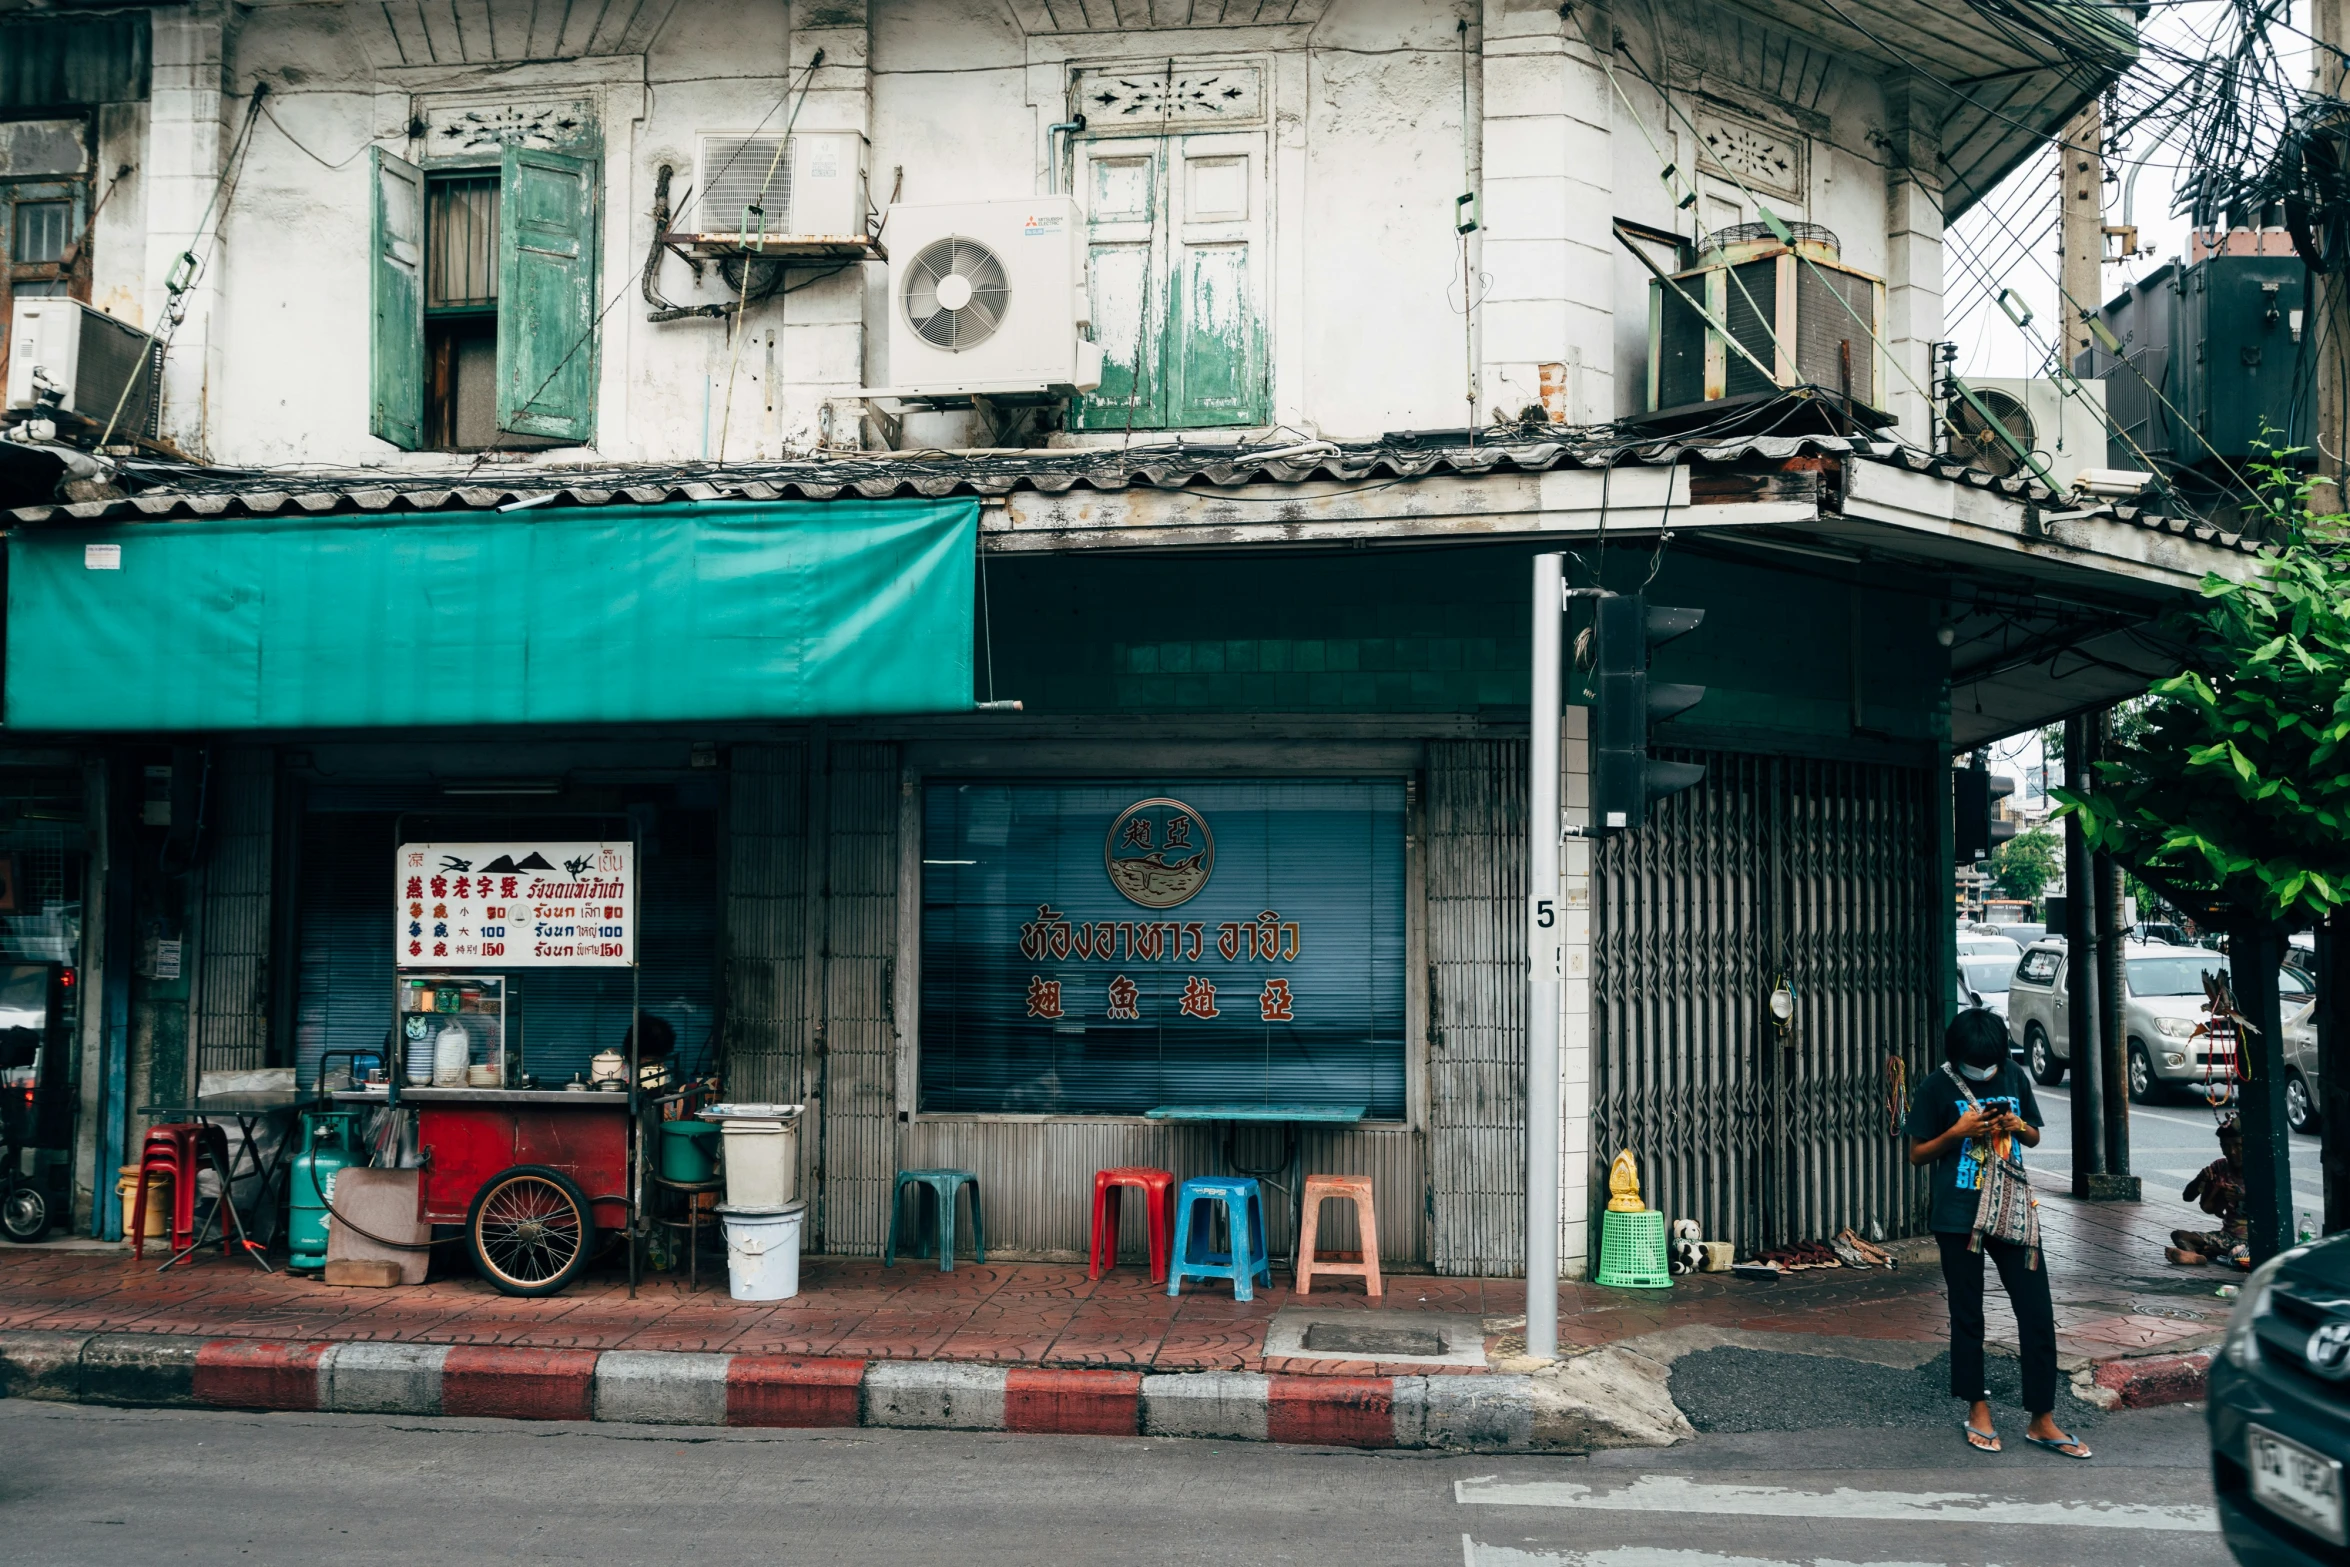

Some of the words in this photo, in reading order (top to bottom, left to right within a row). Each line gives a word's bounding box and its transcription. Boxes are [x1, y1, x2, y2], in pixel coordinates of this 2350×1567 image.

[598, 849, 623, 873] เย็น
[533, 903, 575, 918] รังนก
[581, 902, 600, 918] เล็ก
[1537, 900, 1555, 928] 5
[480, 926, 505, 937] 100
[534, 922, 575, 937] รังนก
[576, 923, 598, 938] ใหญ่
[598, 926, 623, 937] 100
[1020, 903, 1206, 961] ห้องอาหาร
[1216, 909, 1300, 962] อาจิว
[481, 943, 505, 956] 150
[534, 941, 573, 957] รังนก
[576, 943, 599, 956] พิเศษ
[600, 943, 623, 957] 150
